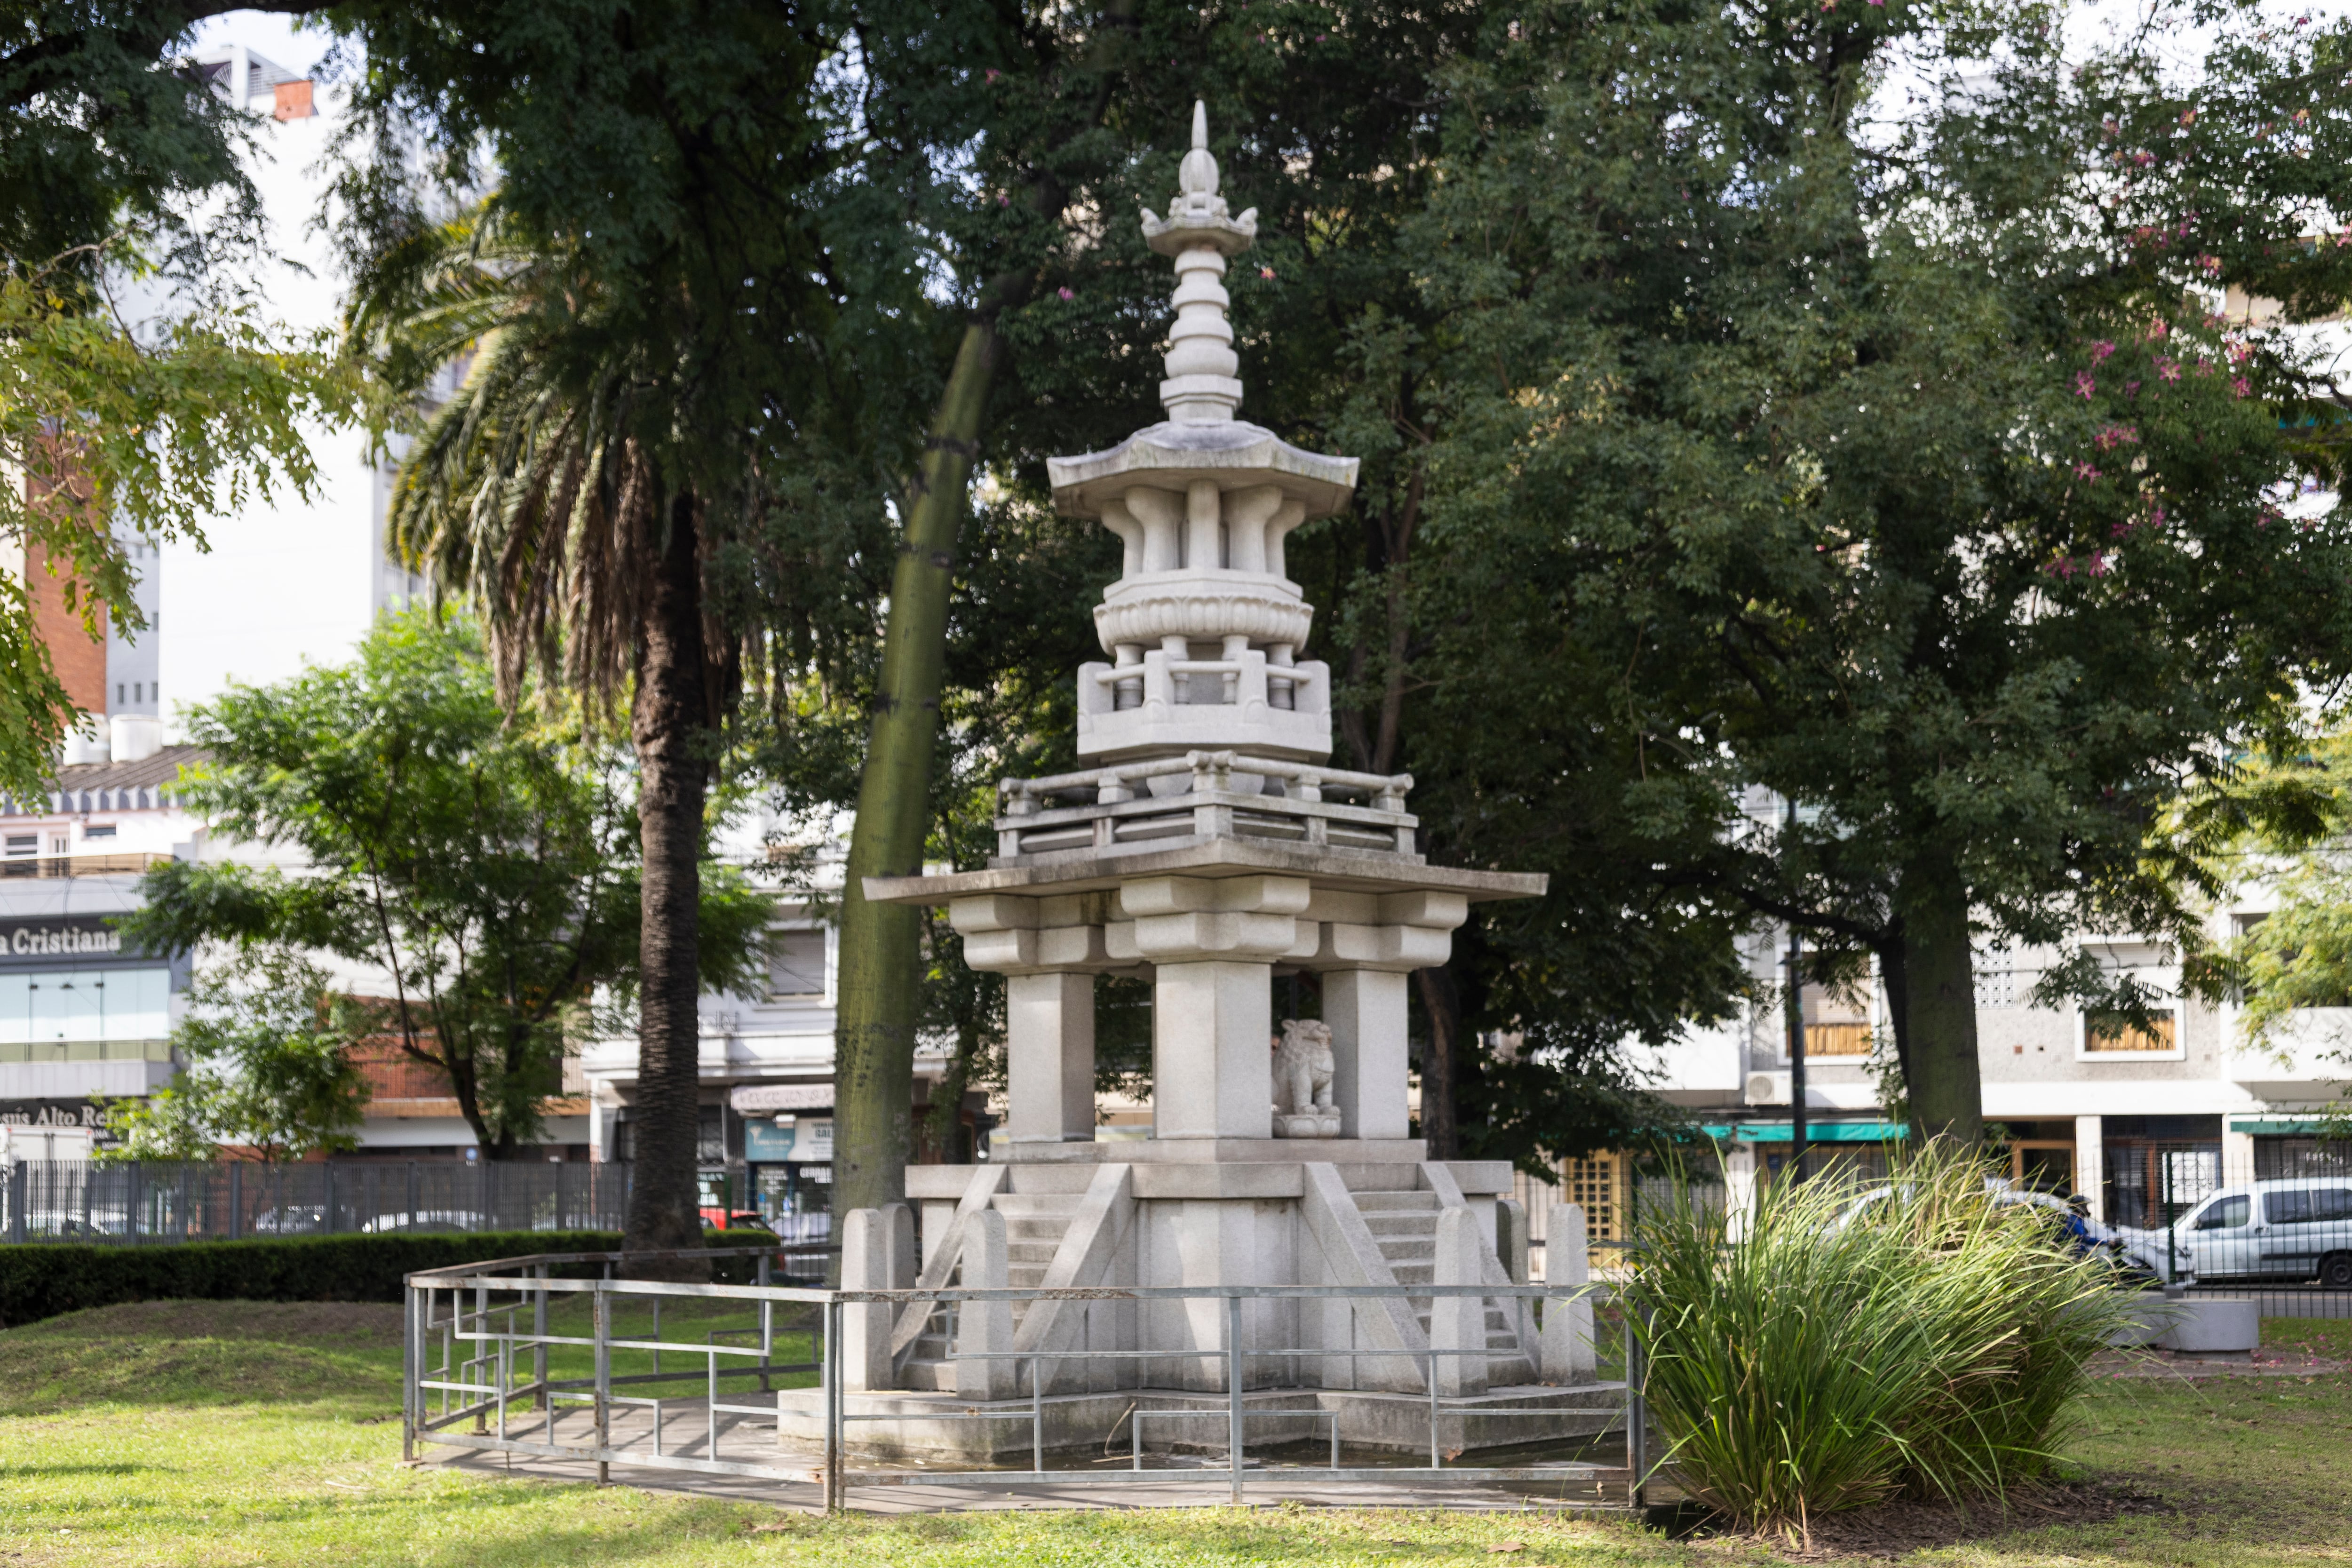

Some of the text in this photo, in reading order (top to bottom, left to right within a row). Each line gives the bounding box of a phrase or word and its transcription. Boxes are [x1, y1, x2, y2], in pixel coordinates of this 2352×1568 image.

[12, 925, 121, 955] Cristiana
[0, 1106, 31, 1125] sús
[33, 1106, 78, 1126] Alto
